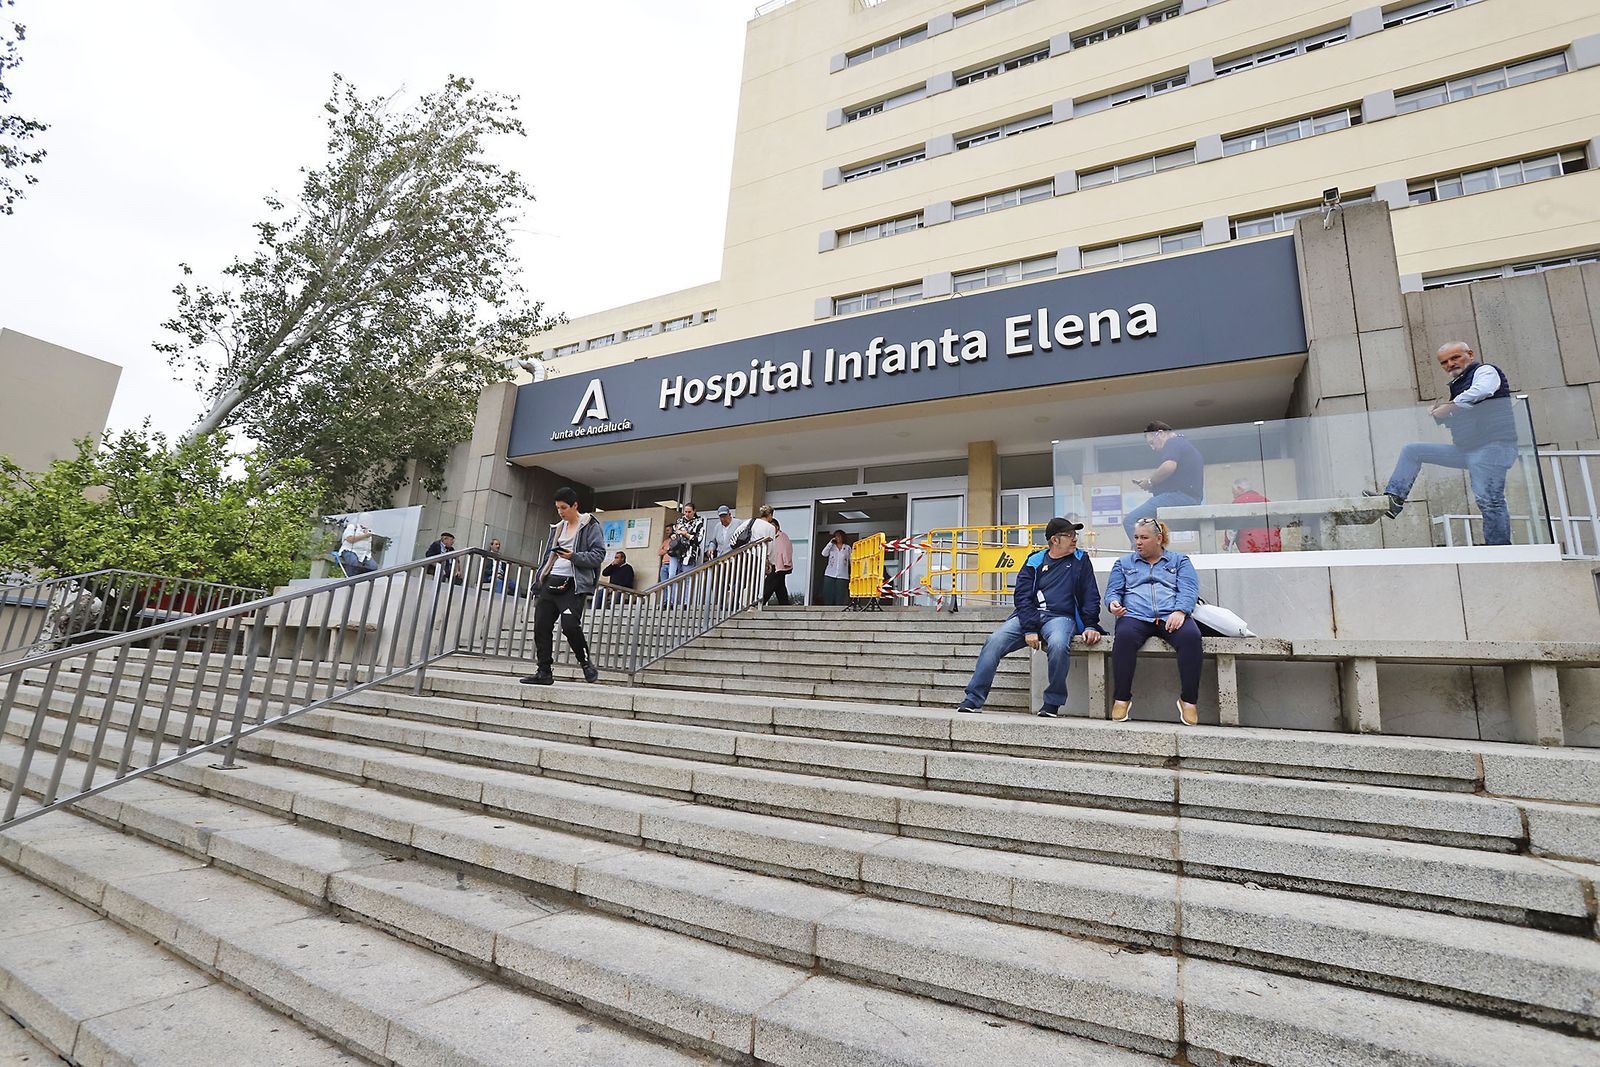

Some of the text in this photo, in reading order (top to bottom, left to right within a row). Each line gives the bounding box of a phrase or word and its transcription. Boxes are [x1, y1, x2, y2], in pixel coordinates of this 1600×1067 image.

[658, 302, 1158, 409] Hospital Infanta Elena
[550, 419, 632, 441] Junta de Andalucía
